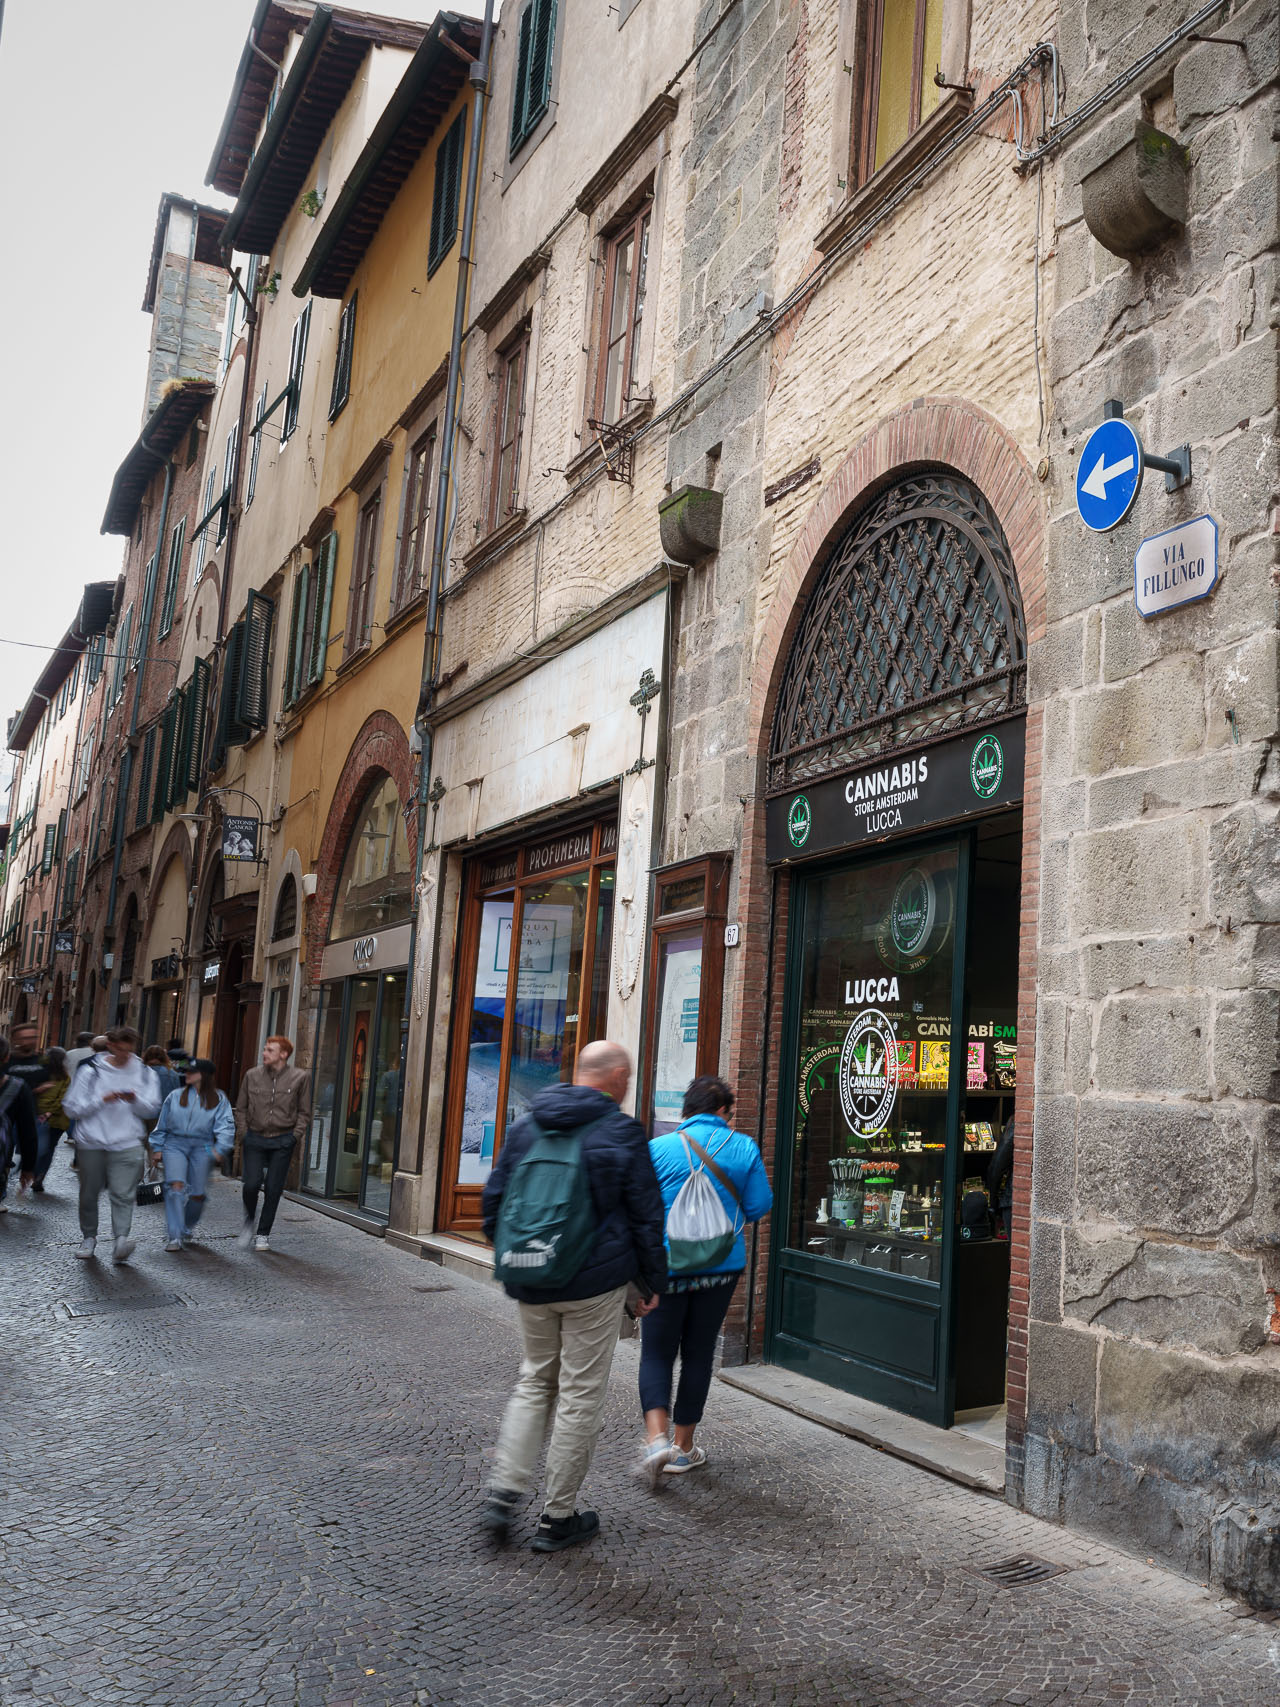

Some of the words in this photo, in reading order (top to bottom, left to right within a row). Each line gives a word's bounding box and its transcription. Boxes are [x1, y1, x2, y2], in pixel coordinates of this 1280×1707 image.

[1163, 541, 1185, 566] VIA
[1143, 557, 1205, 597] FILLUNGO
[845, 756, 928, 804] CANNABIS
[854, 798, 875, 817] STORE
[875, 787, 919, 811] AMSTERDAM
[866, 808, 903, 833] LUCCA
[529, 834, 590, 871] PROFUMERIA
[506, 923, 548, 931] AQUA
[898, 910, 921, 922] CANNABIS
[353, 938, 377, 961] KIKO
[728, 929, 736, 942] 67
[845, 977, 900, 1004] LUCCA
[843, 1015, 872, 1063] AMSTERDAM
[801, 1046, 840, 1081] AMSTERDAM
[841, 1065, 853, 1116] ORIGINAL
[850, 1075, 886, 1088] CANNABIS
[864, 1083, 894, 1131] AMSTERDAM
